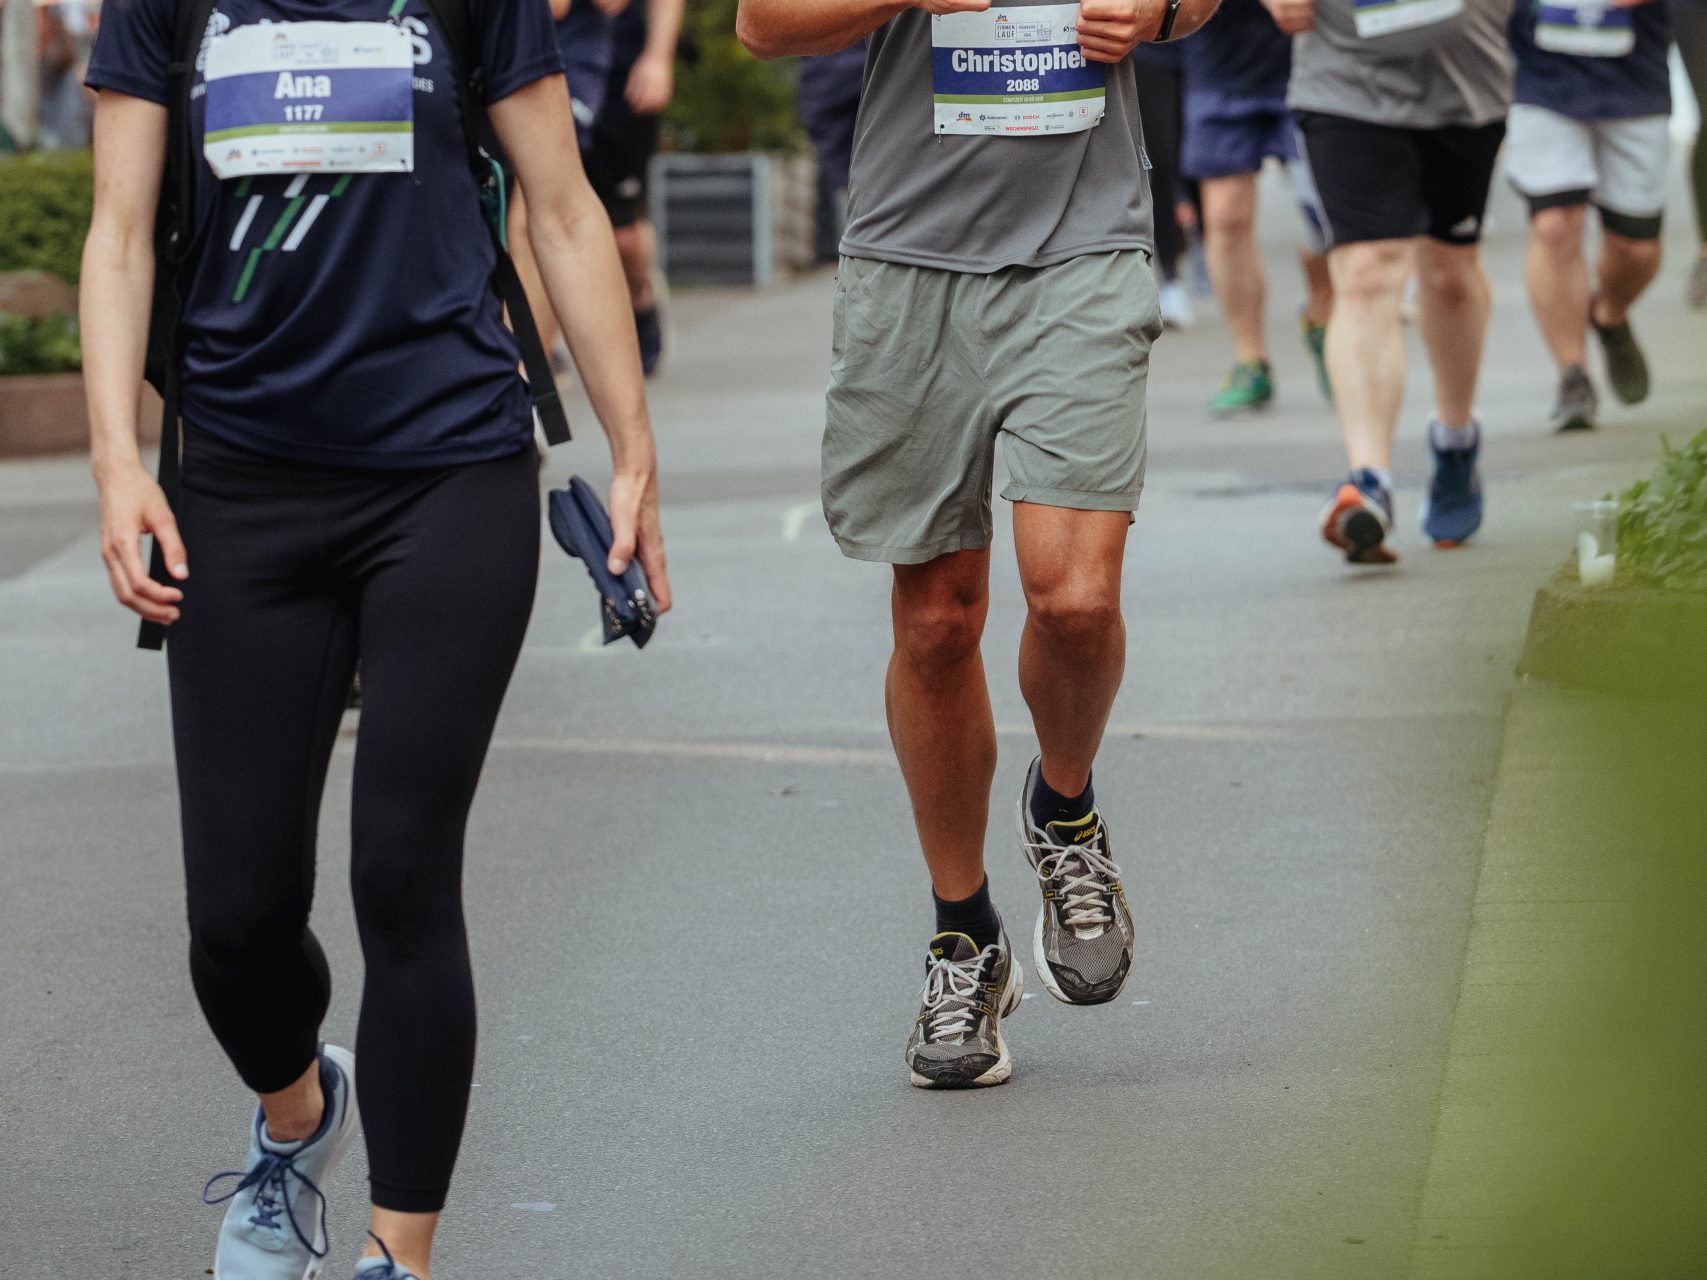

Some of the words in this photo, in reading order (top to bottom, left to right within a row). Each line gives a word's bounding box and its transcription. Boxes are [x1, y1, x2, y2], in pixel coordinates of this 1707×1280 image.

[274, 71, 331, 100] Ana
[1006, 78, 1040, 92] 2088
[283, 104, 324, 121] 1177
